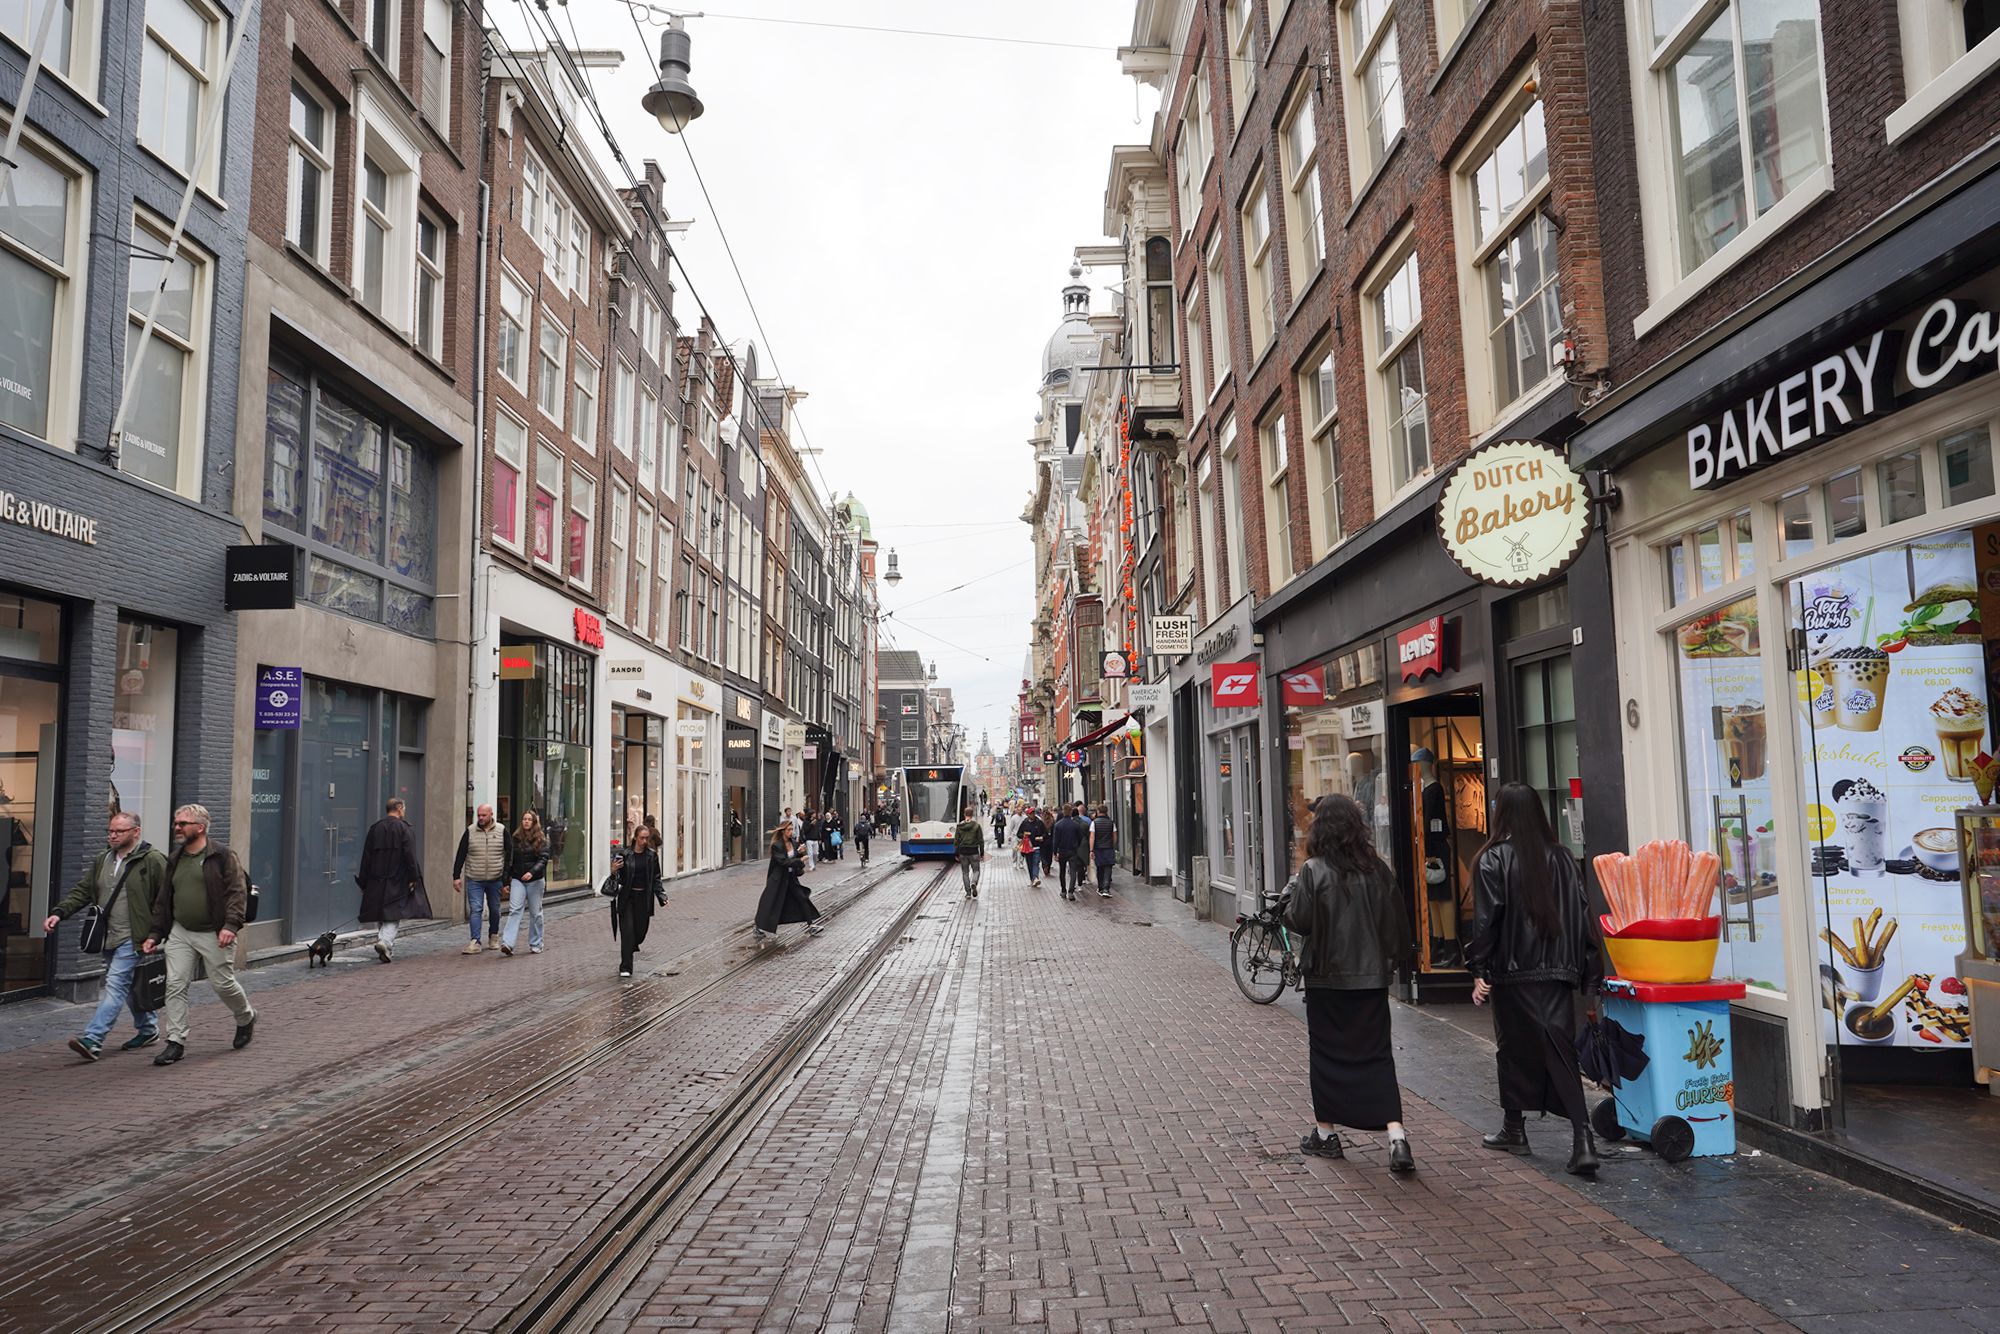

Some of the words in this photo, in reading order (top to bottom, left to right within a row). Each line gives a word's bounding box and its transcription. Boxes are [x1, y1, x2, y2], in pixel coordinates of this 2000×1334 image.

[3, 377, 32, 400] VOLTAIRE
[1687, 329, 1885, 490] BAKERY
[1906, 298, 2000, 389] Ca
[1473, 459, 1543, 491] DUTCH
[1456, 483, 1576, 545] Bakery
[16, 501, 30, 525] &
[31, 501, 98, 545] VOLTAIRE
[233, 573, 252, 582] ZADIG
[258, 572, 288, 581] VOLTAIRE
[1814, 595, 1849, 615] Tea
[1804, 607, 1851, 631] Bubble
[1155, 621, 1188, 630] LUSH
[1156, 631, 1188, 639] FRESH
[263, 670, 297, 681] A.S.E.
[1901, 666, 1974, 677] FRAPPUCCINO
[1626, 698, 1640, 729] 6
[680, 724, 705, 733] maje
[728, 739, 751, 748] RAINS
[928, 770, 937, 779] 24
[1920, 794, 1974, 803] Cappucino
[1829, 886, 1866, 895] Churros
[1920, 923, 1950, 932] Fresh
[1676, 1081, 1734, 1111] CHURROS
